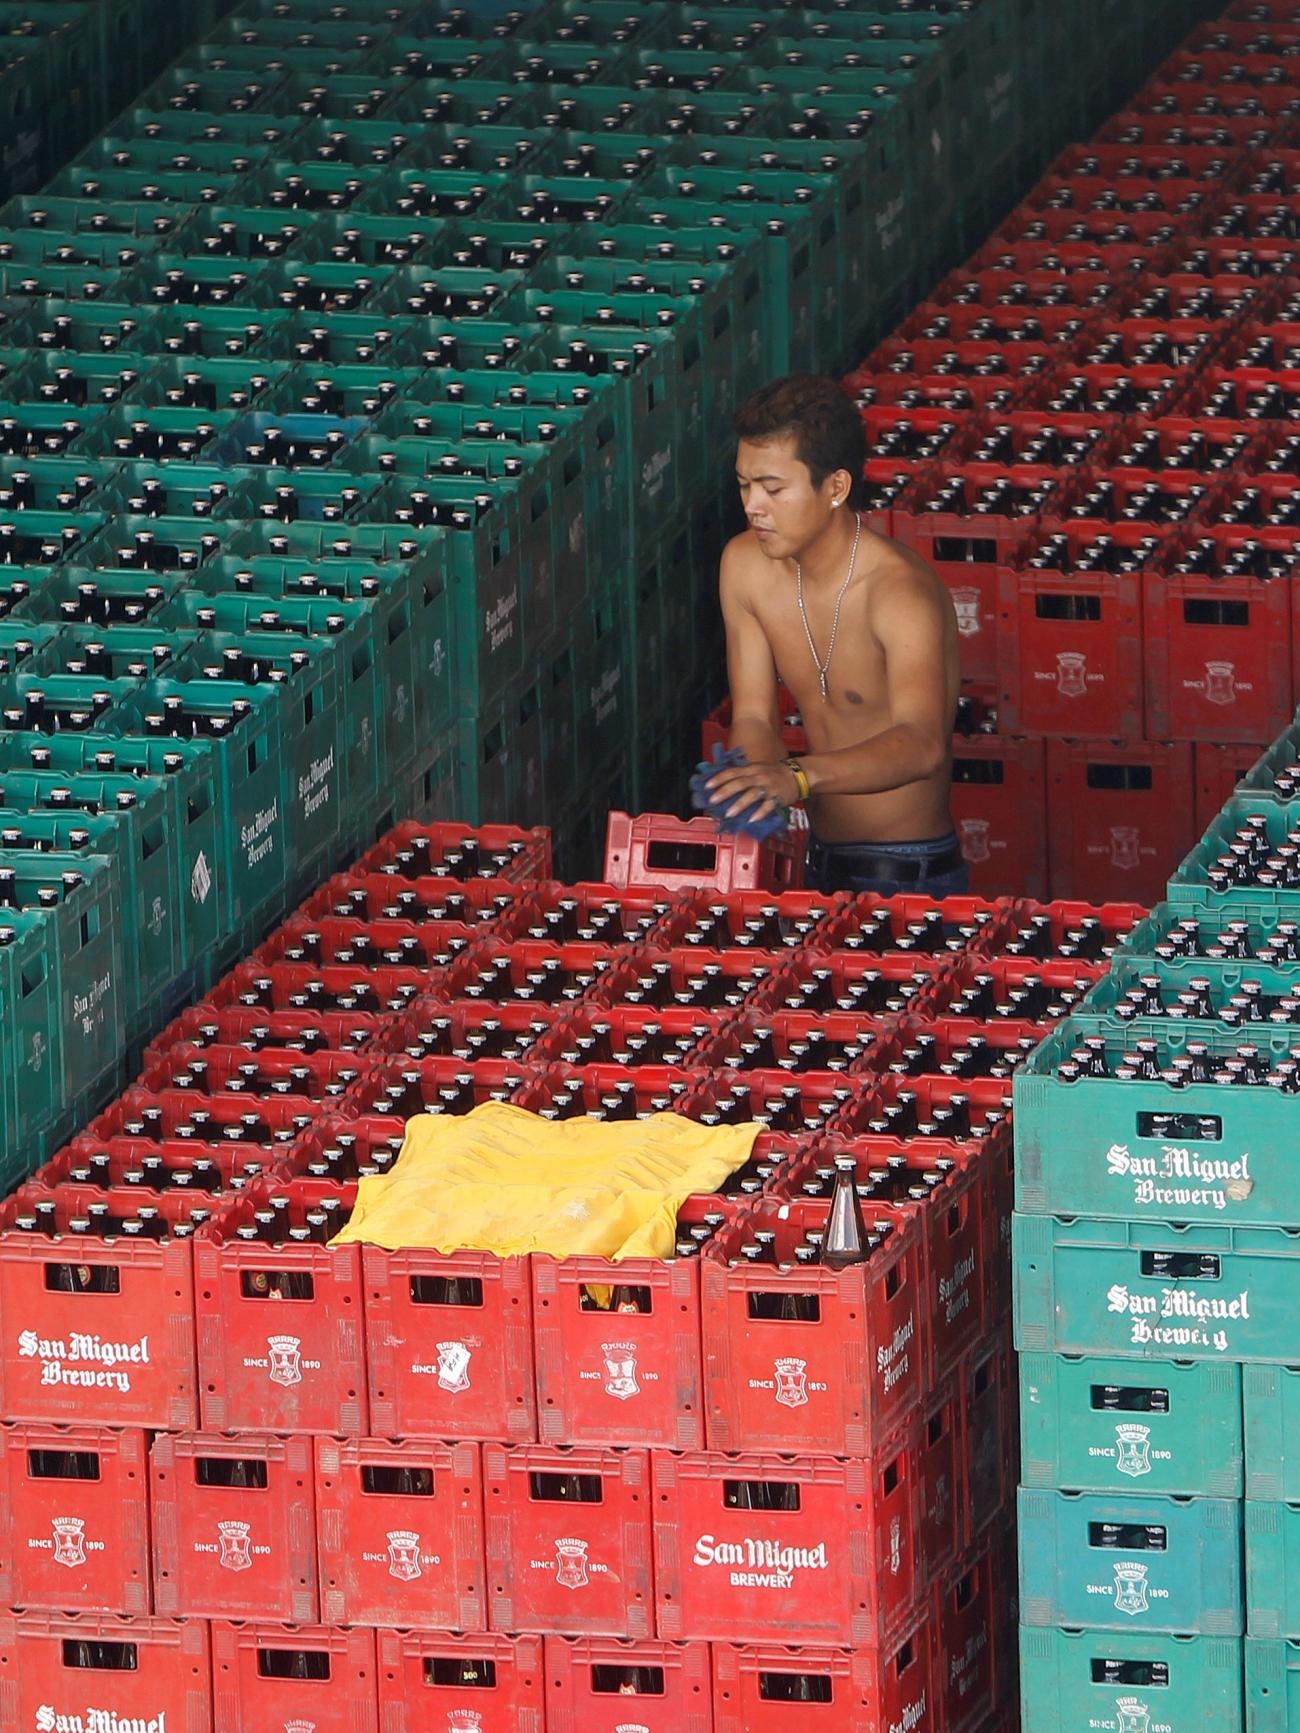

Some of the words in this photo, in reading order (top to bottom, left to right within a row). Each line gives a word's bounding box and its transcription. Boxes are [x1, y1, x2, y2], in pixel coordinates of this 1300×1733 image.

[1106, 1144, 1158, 1176] San
[1159, 1145, 1250, 1184] Miguel
[1134, 1178, 1227, 1210] Brewery
[1107, 1284, 1157, 1314] San
[1161, 1288, 1250, 1324] Miguel
[18, 1329, 66, 1356] San
[68, 1331, 150, 1366] Miguel
[243, 1357, 268, 1368] SINCE
[301, 1360, 321, 1369] 1890
[411, 1364, 437, 1374] SINCE
[41, 1360, 131, 1392] Brewery
[749, 1379, 775, 1389] SINCE
[1088, 1447, 1116, 1457] SINCE
[1151, 1450, 1172, 1460] 1890
[28, 1538, 52, 1549] SINCE
[85, 1541, 105, 1550] 1890
[194, 1543, 219, 1553] SINCE
[251, 1546, 271, 1555] 1890
[362, 1552, 387, 1562] SINCE
[421, 1556, 440, 1565] 1890
[693, 1534, 745, 1567] San
[744, 1538, 829, 1575] Miguel
[530, 1560, 555, 1570] SINCE
[588, 1563, 608, 1573] 1890
[729, 1572, 794, 1589] BREWERY
[1086, 1585, 1113, 1595] SINCE
[1149, 1589, 1169, 1598] 1890
[35, 1705, 84, 1733] San
[86, 1708, 166, 1733] Miguel
[1151, 1724, 1172, 1733] 1890
